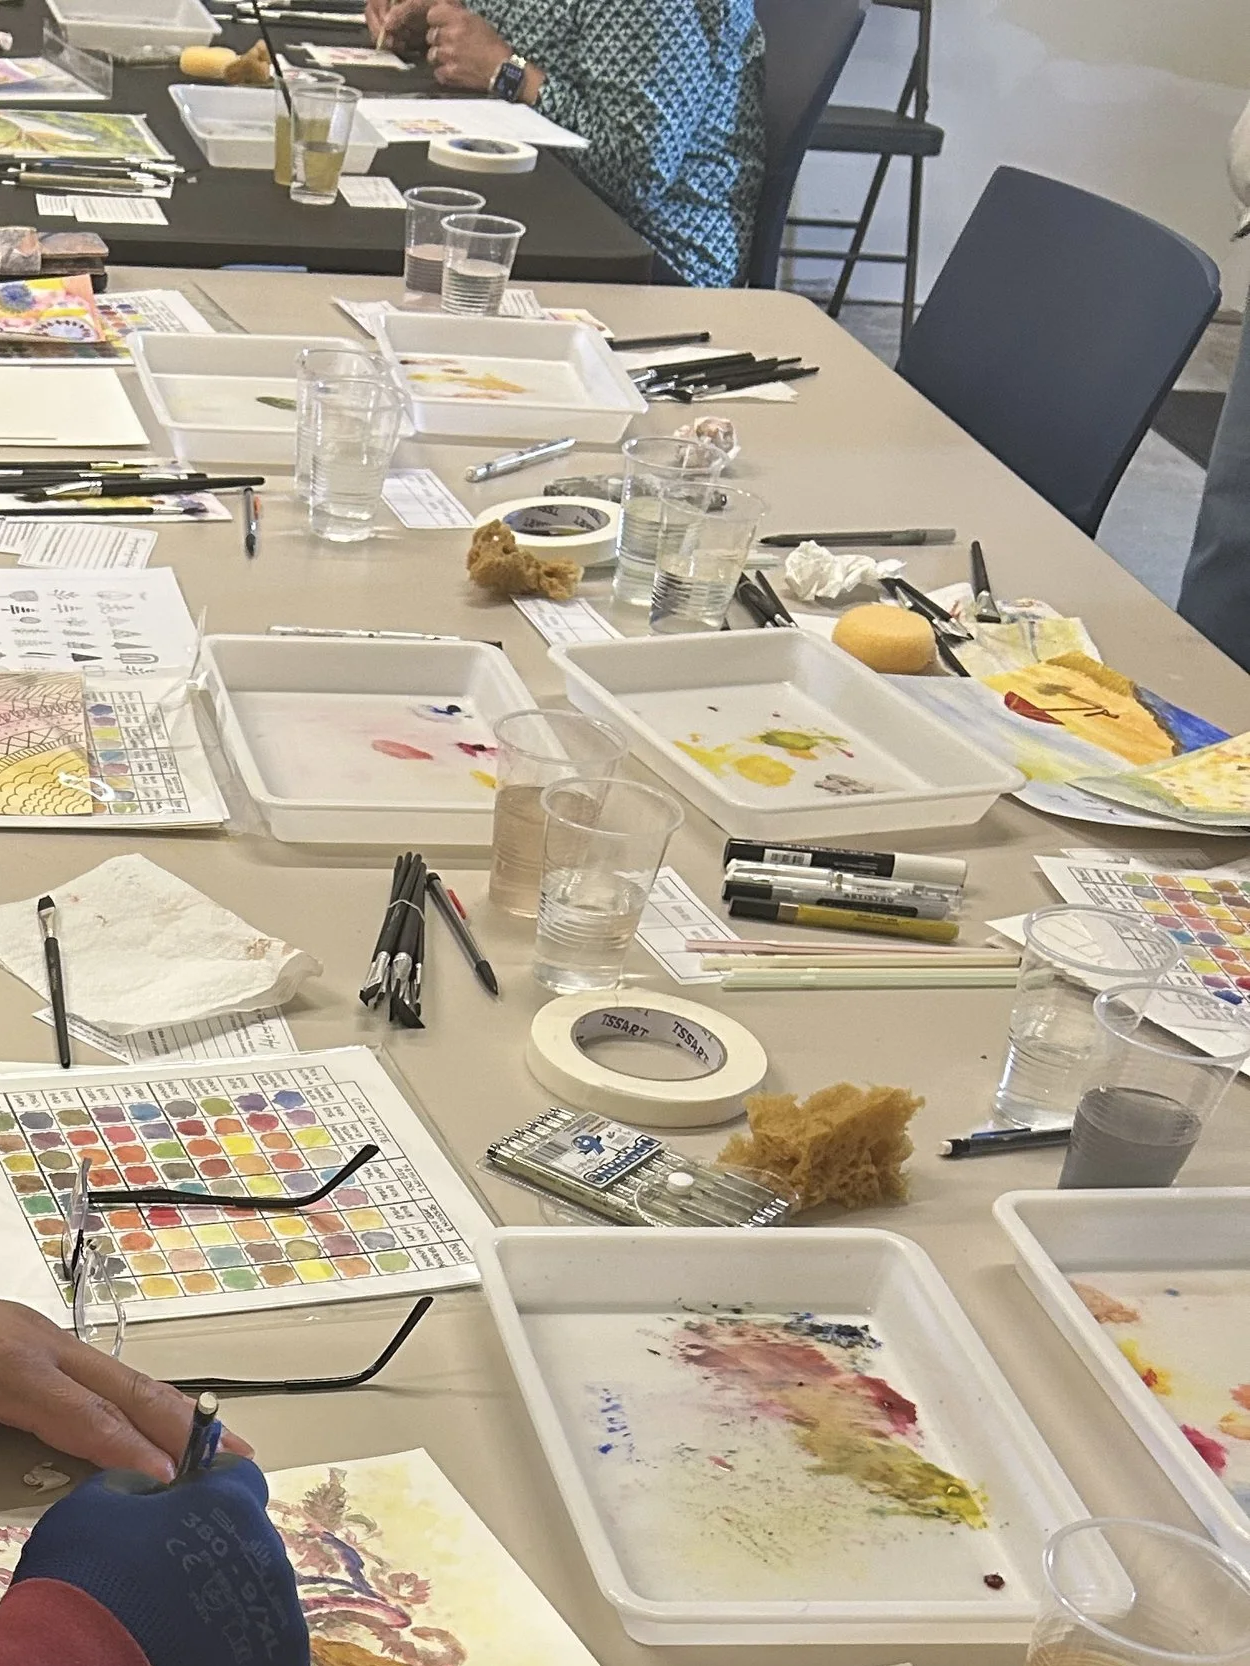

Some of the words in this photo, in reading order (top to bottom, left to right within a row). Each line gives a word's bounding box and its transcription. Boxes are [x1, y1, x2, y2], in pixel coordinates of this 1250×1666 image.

[600, 1012, 650, 1038] TSSART
[671, 1020, 710, 1065] TSSART
[351, 1097, 370, 1115] CORE
[364, 1115, 392, 1145] PALETTE
